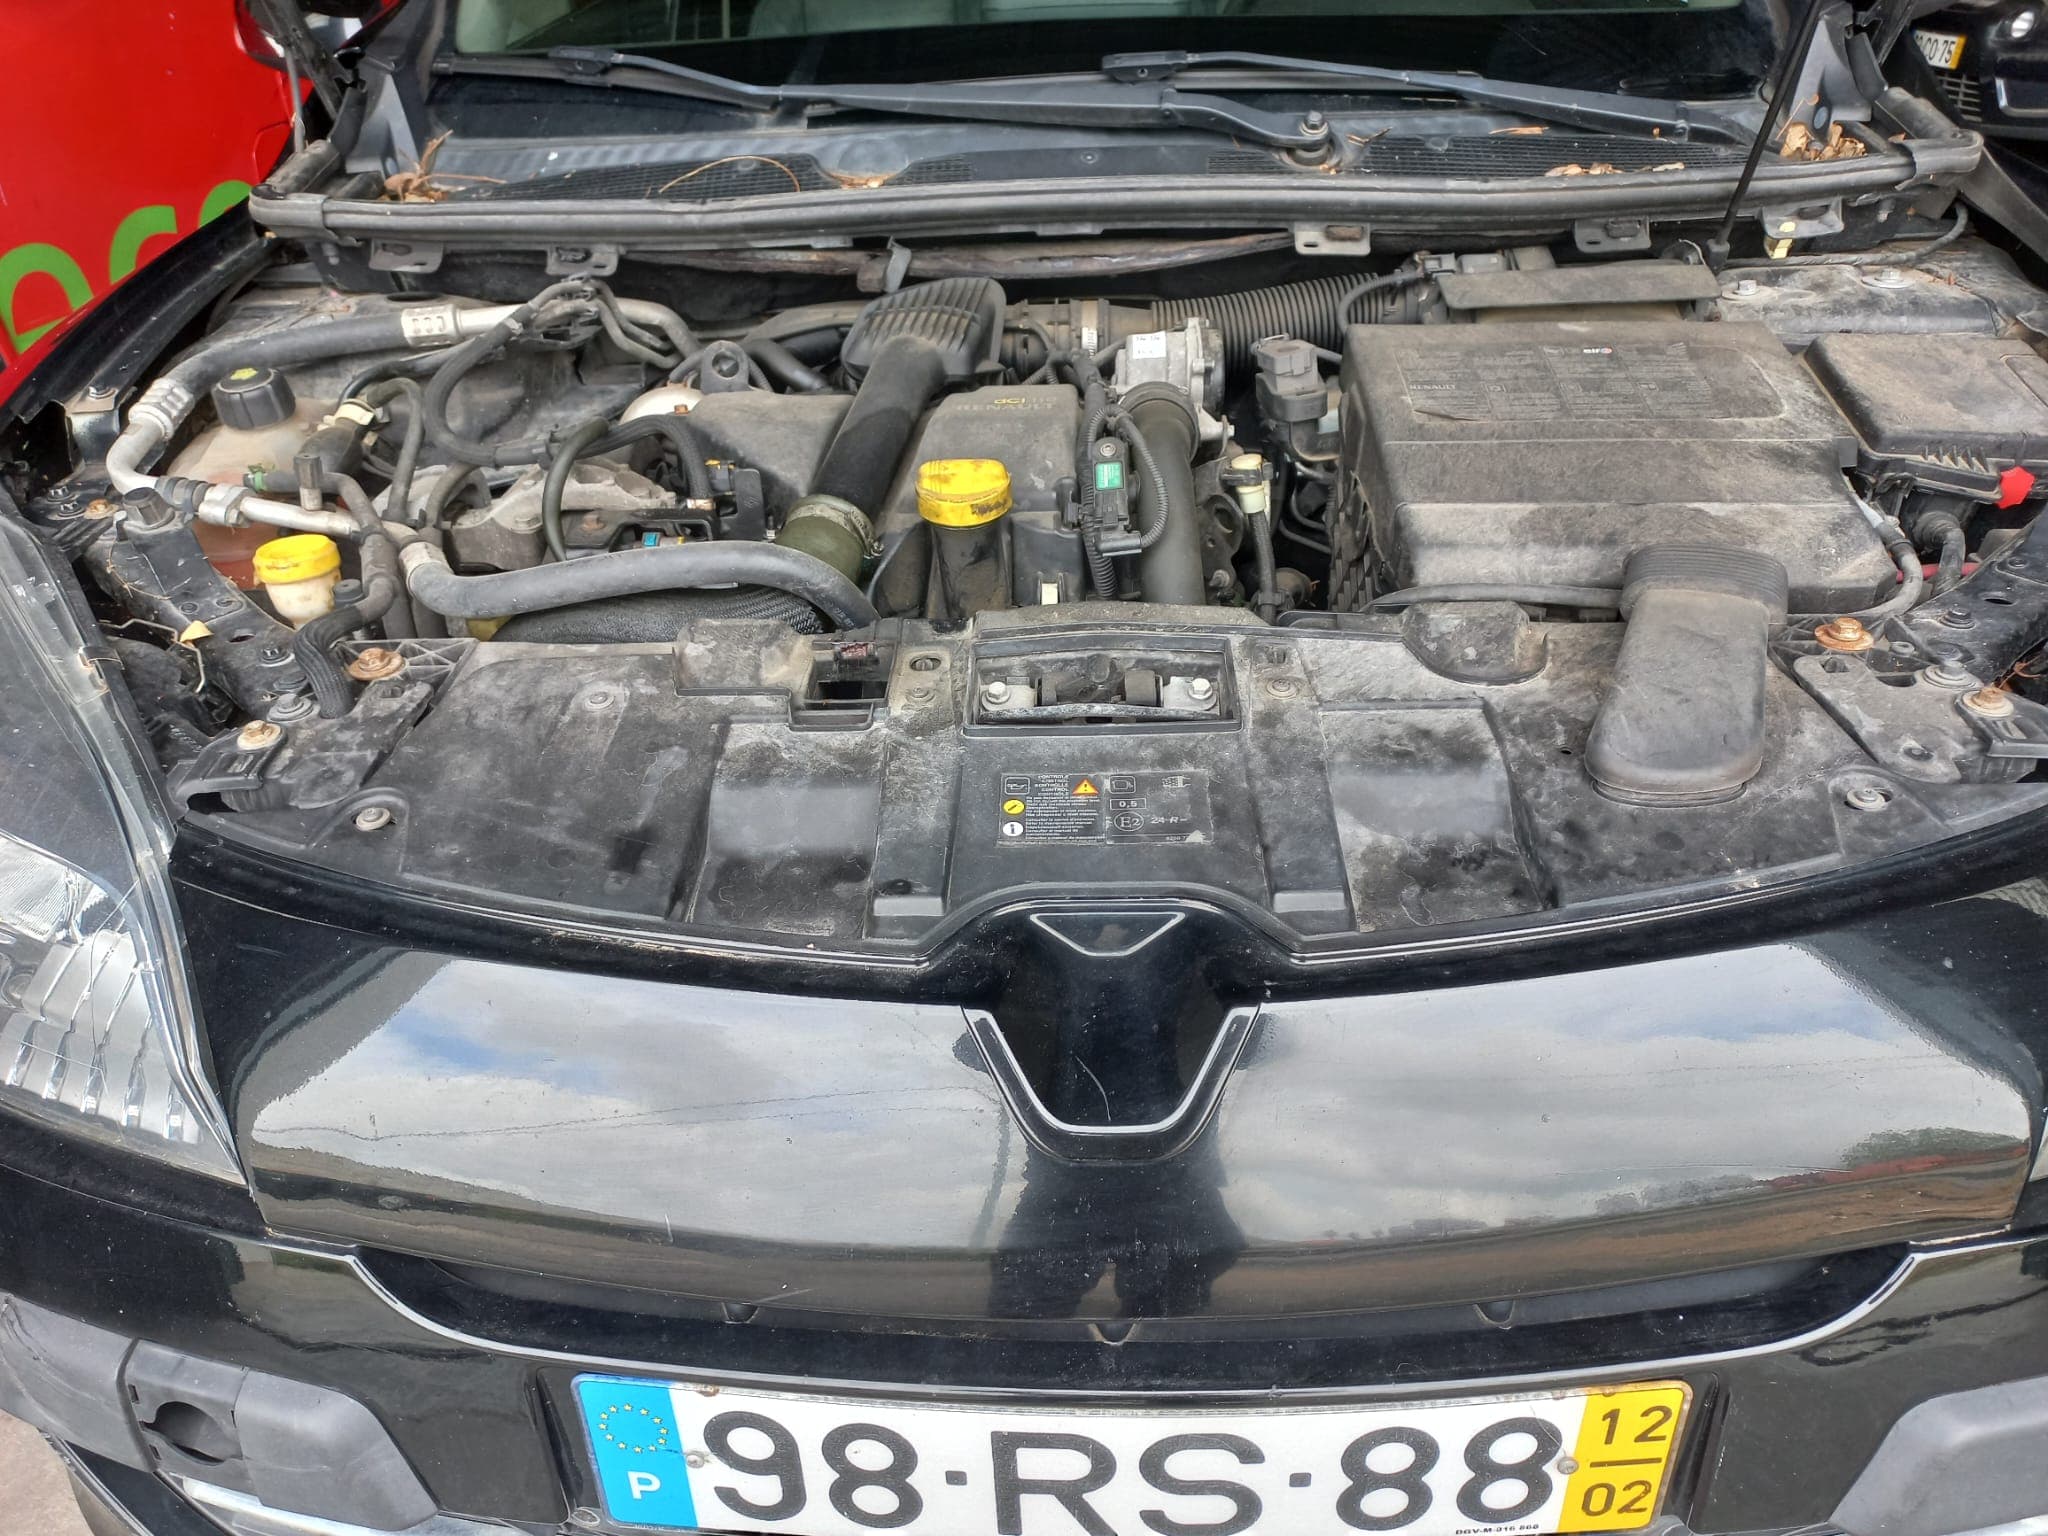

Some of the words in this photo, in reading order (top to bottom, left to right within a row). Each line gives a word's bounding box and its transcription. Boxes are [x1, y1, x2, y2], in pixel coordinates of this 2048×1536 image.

[1119, 800, 1138, 808] 0,5
[1120, 816, 1140, 828] E2
[1601, 1405, 1673, 1446] 12
[627, 1470, 661, 1500] P
[1581, 1479, 1653, 1517] 02
